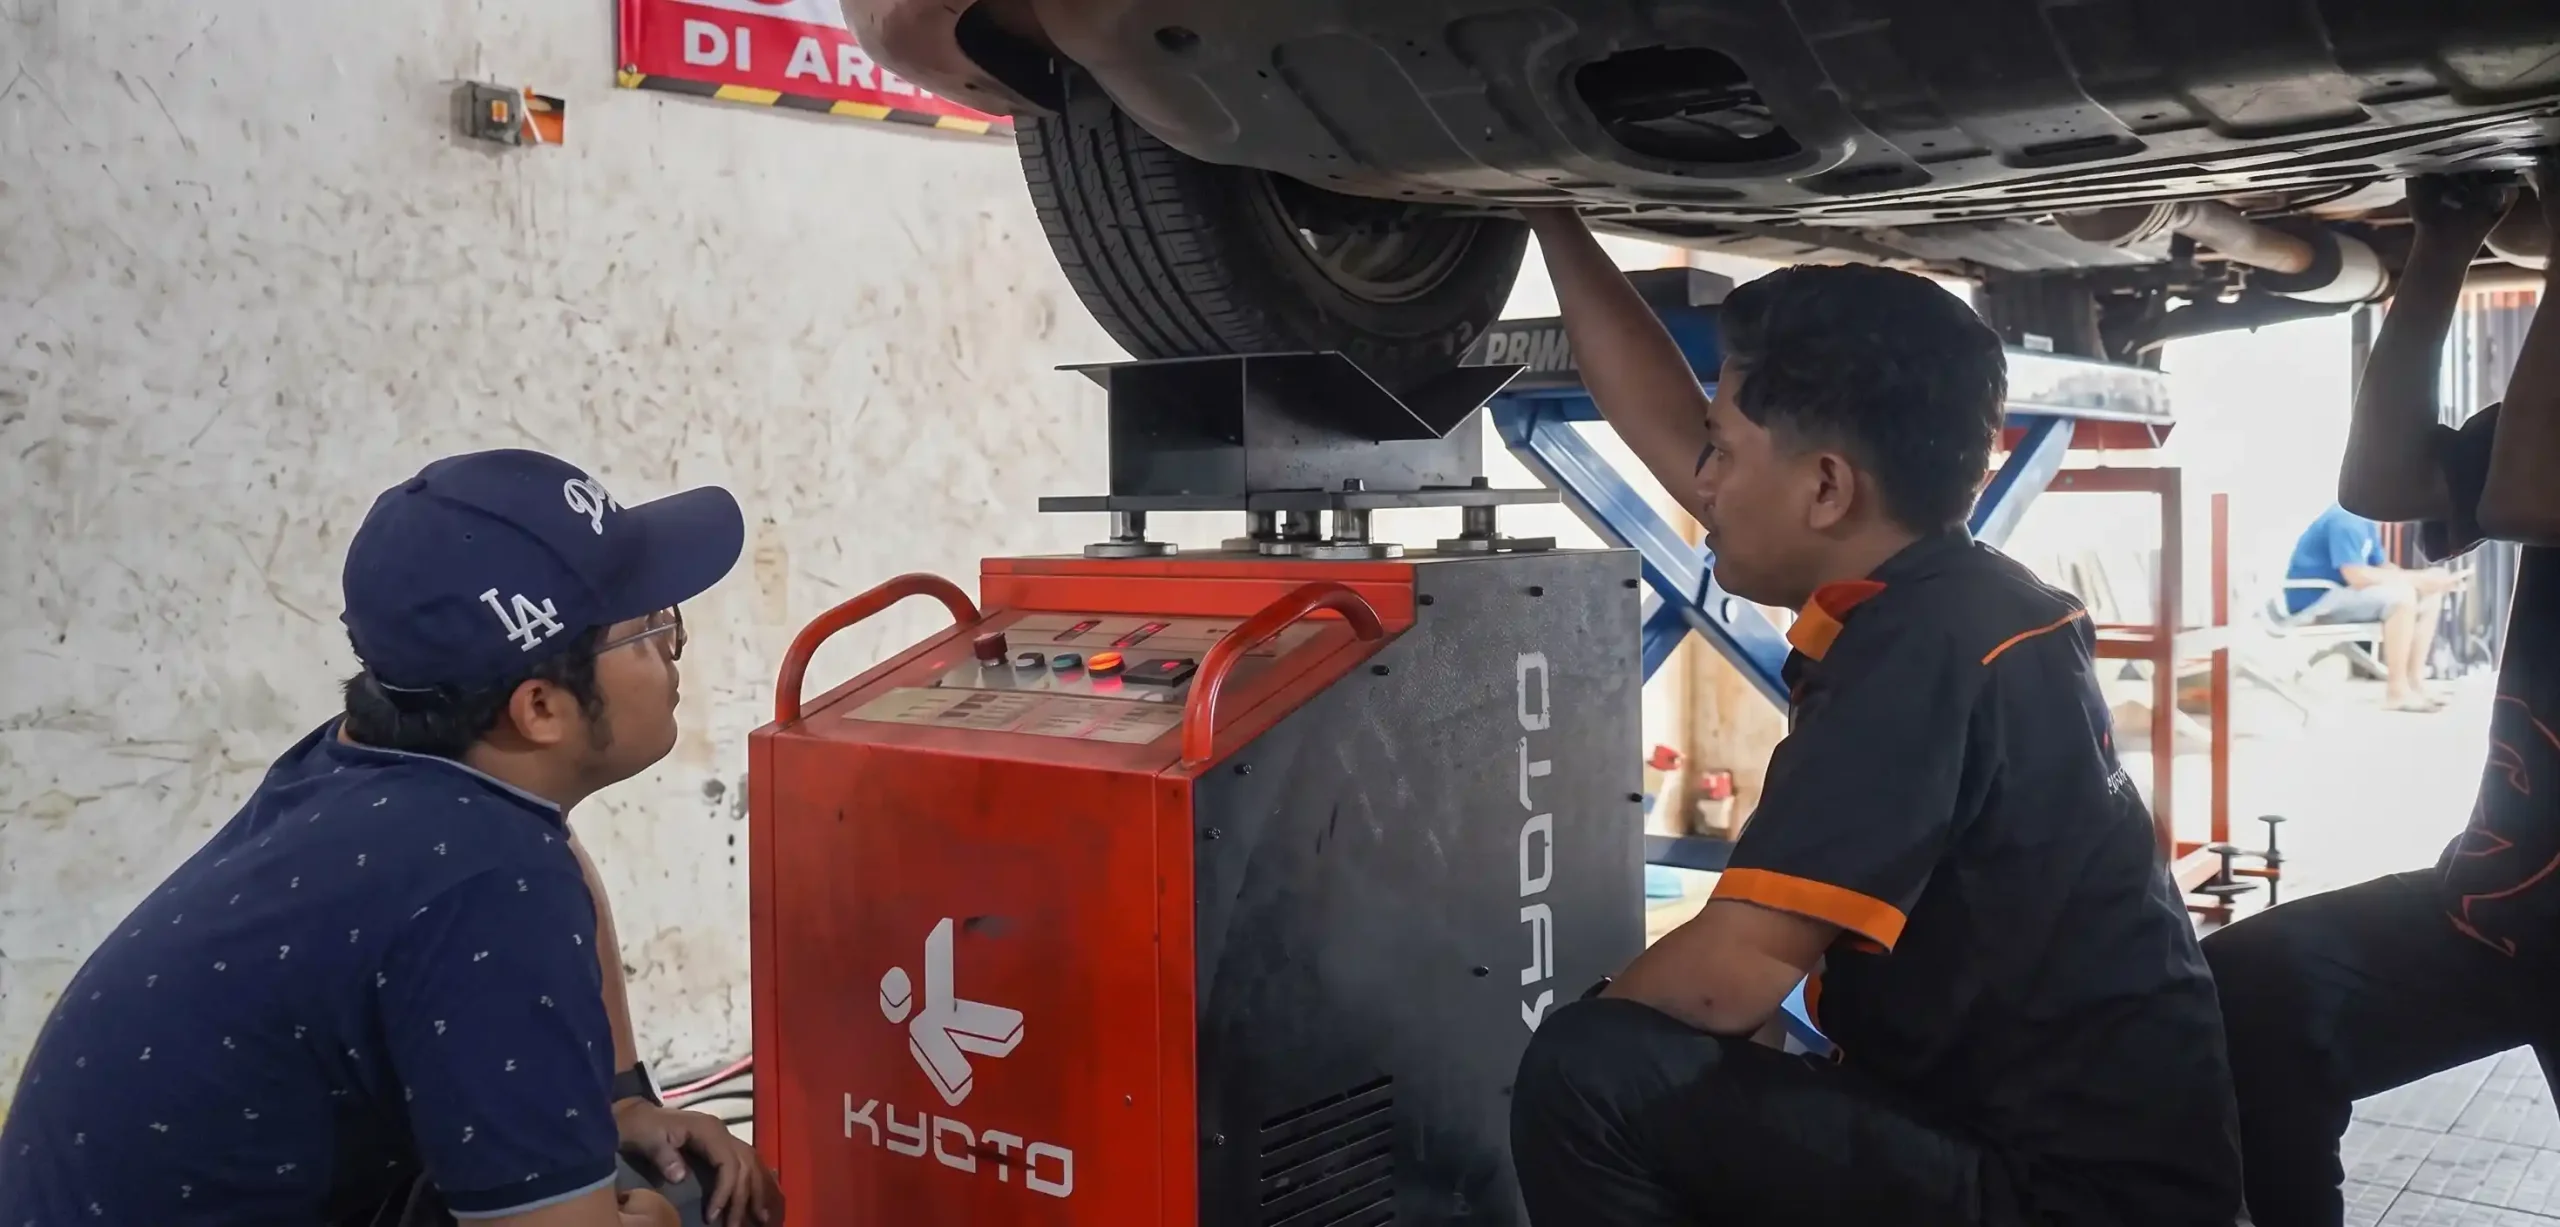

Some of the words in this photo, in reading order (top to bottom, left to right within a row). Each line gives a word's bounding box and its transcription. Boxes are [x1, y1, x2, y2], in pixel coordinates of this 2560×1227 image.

[684, 19, 751, 72] DI
[785, 36, 933, 98] ARE
[1484, 329, 1579, 372] PRIM
[480, 588, 565, 652] LA
[844, 1093, 1073, 1198] KYOTO
